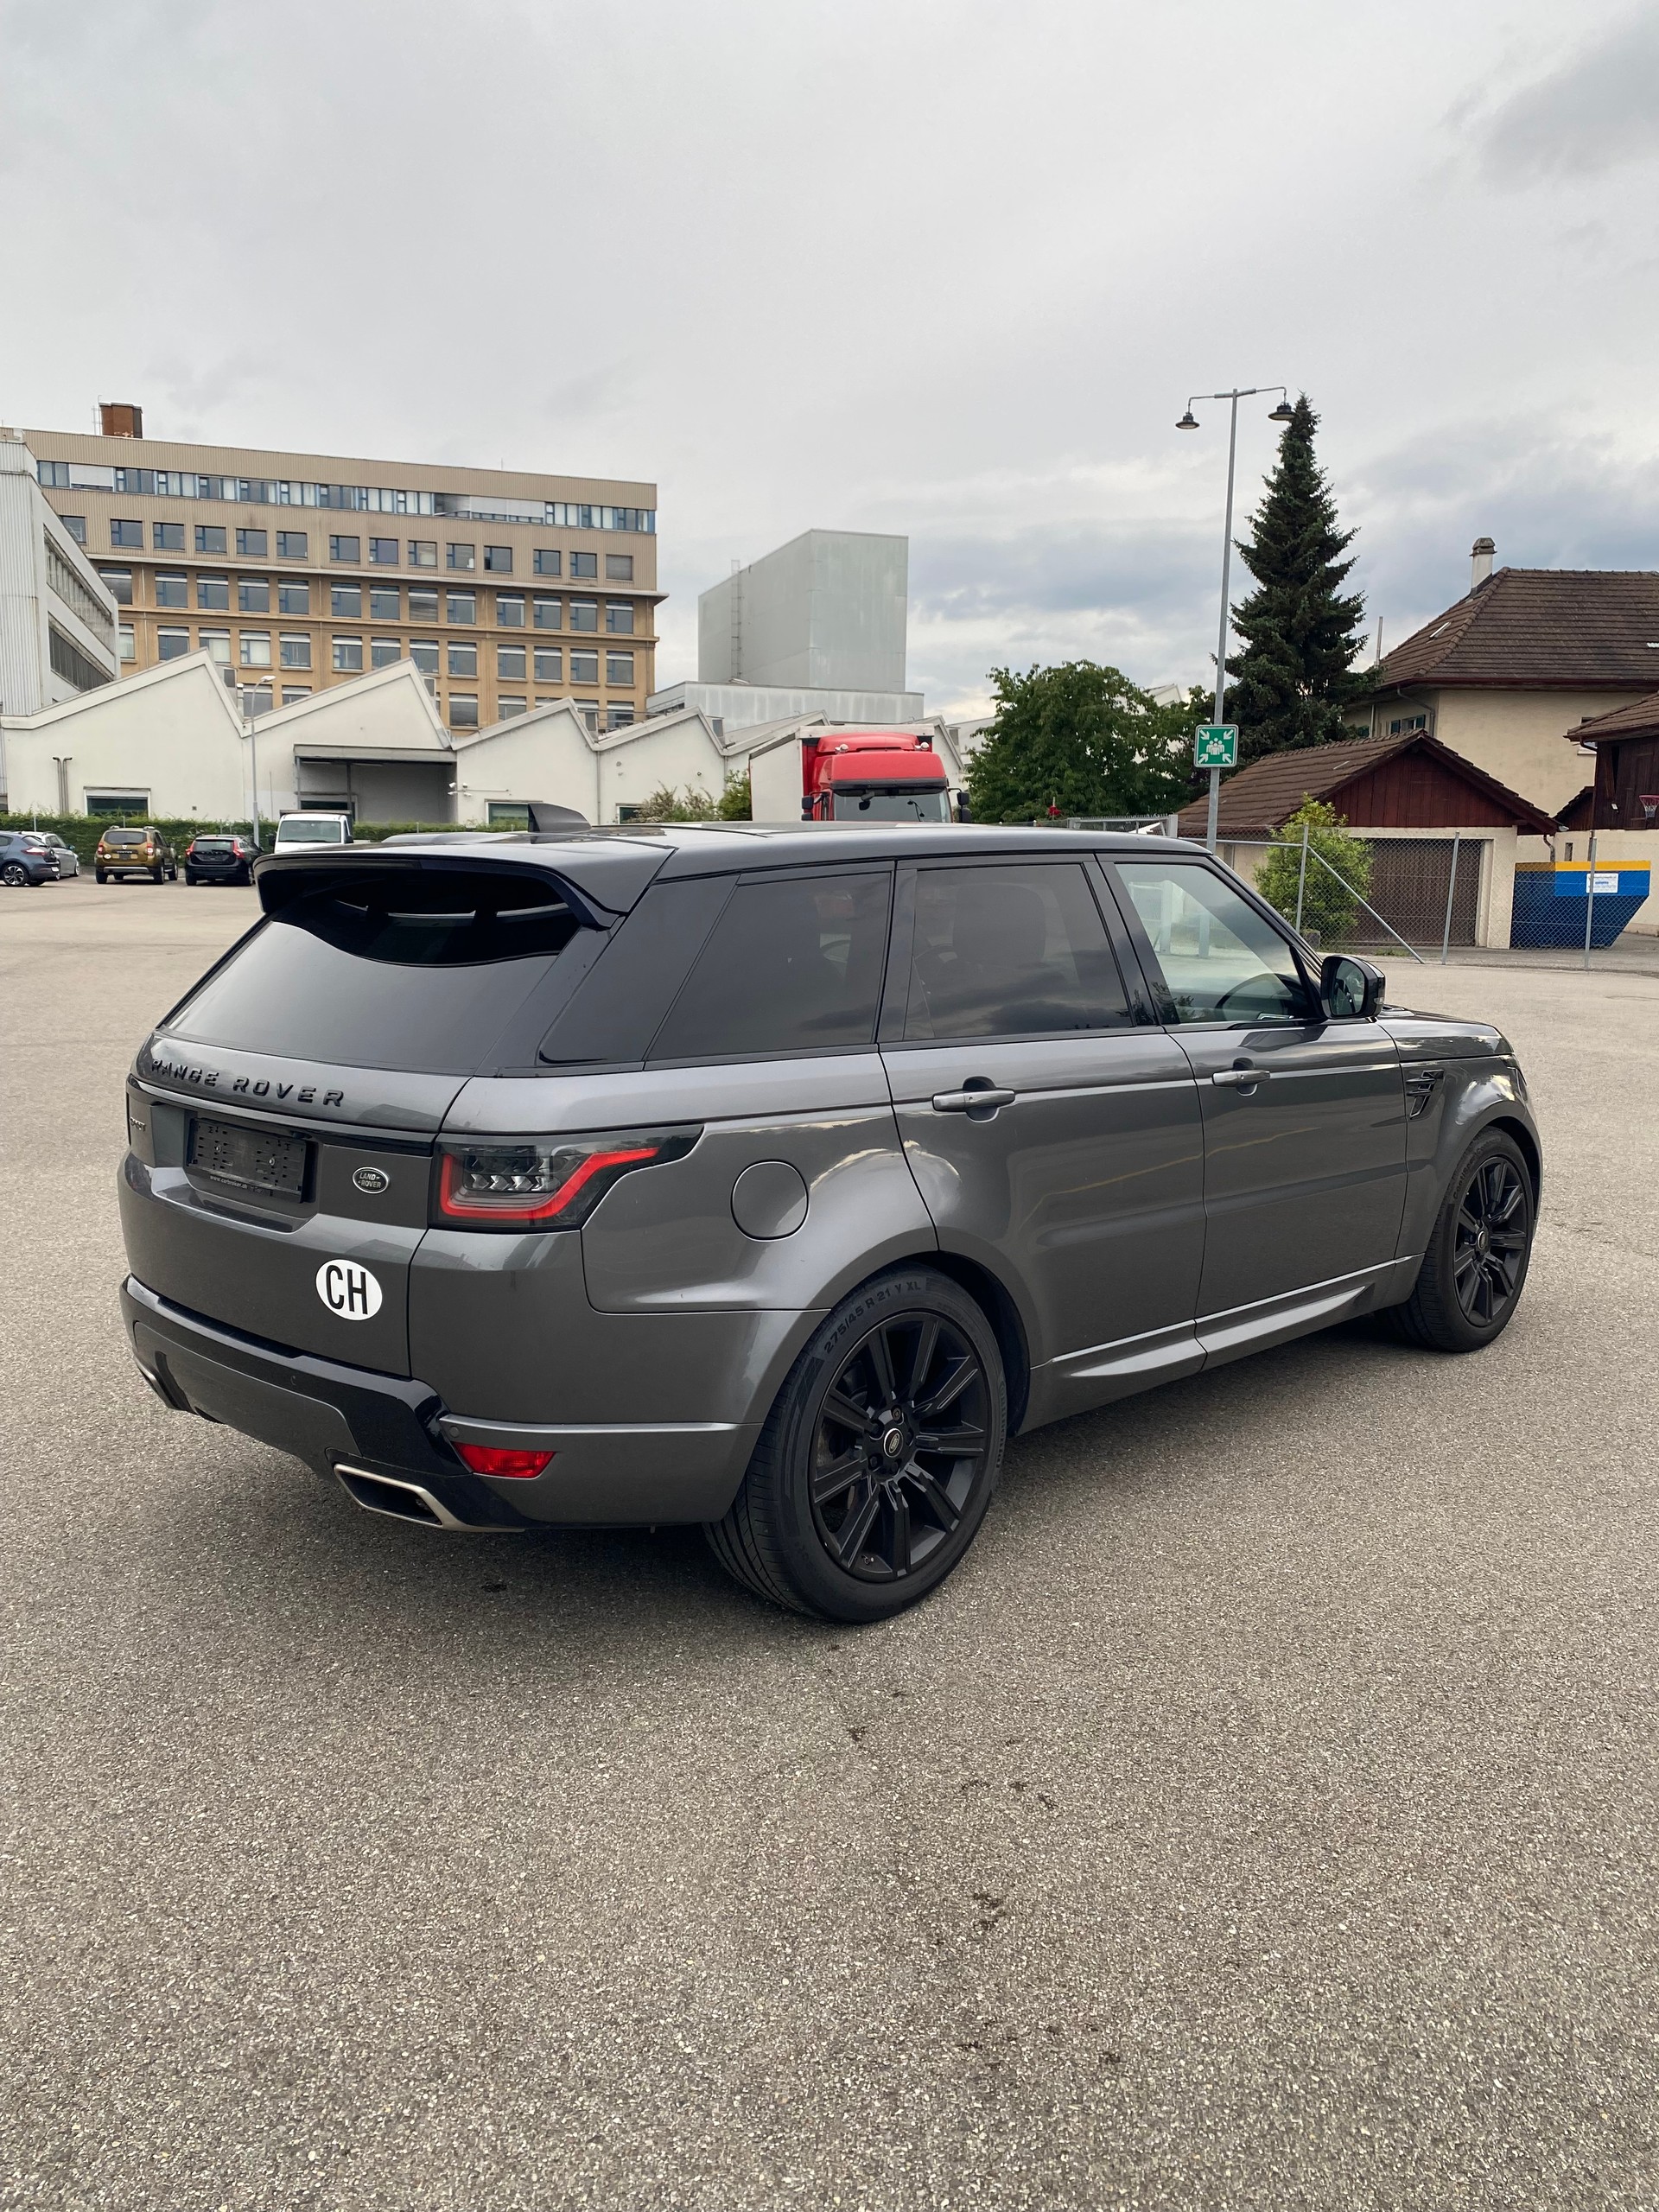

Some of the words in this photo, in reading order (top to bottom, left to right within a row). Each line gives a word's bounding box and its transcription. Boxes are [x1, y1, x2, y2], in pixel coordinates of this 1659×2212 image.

[151, 1058, 219, 1087] RANGE
[232, 1076, 344, 1107] ROVER
[359, 1172, 377, 1180] LAND
[360, 1179, 382, 1188] ROVER
[326, 1264, 368, 1314] CH
[824, 1306, 865, 1354] 275/45
[865, 1298, 875, 1308] R
[876, 1288, 891, 1301] 21
[906, 1281, 921, 1292] XL
